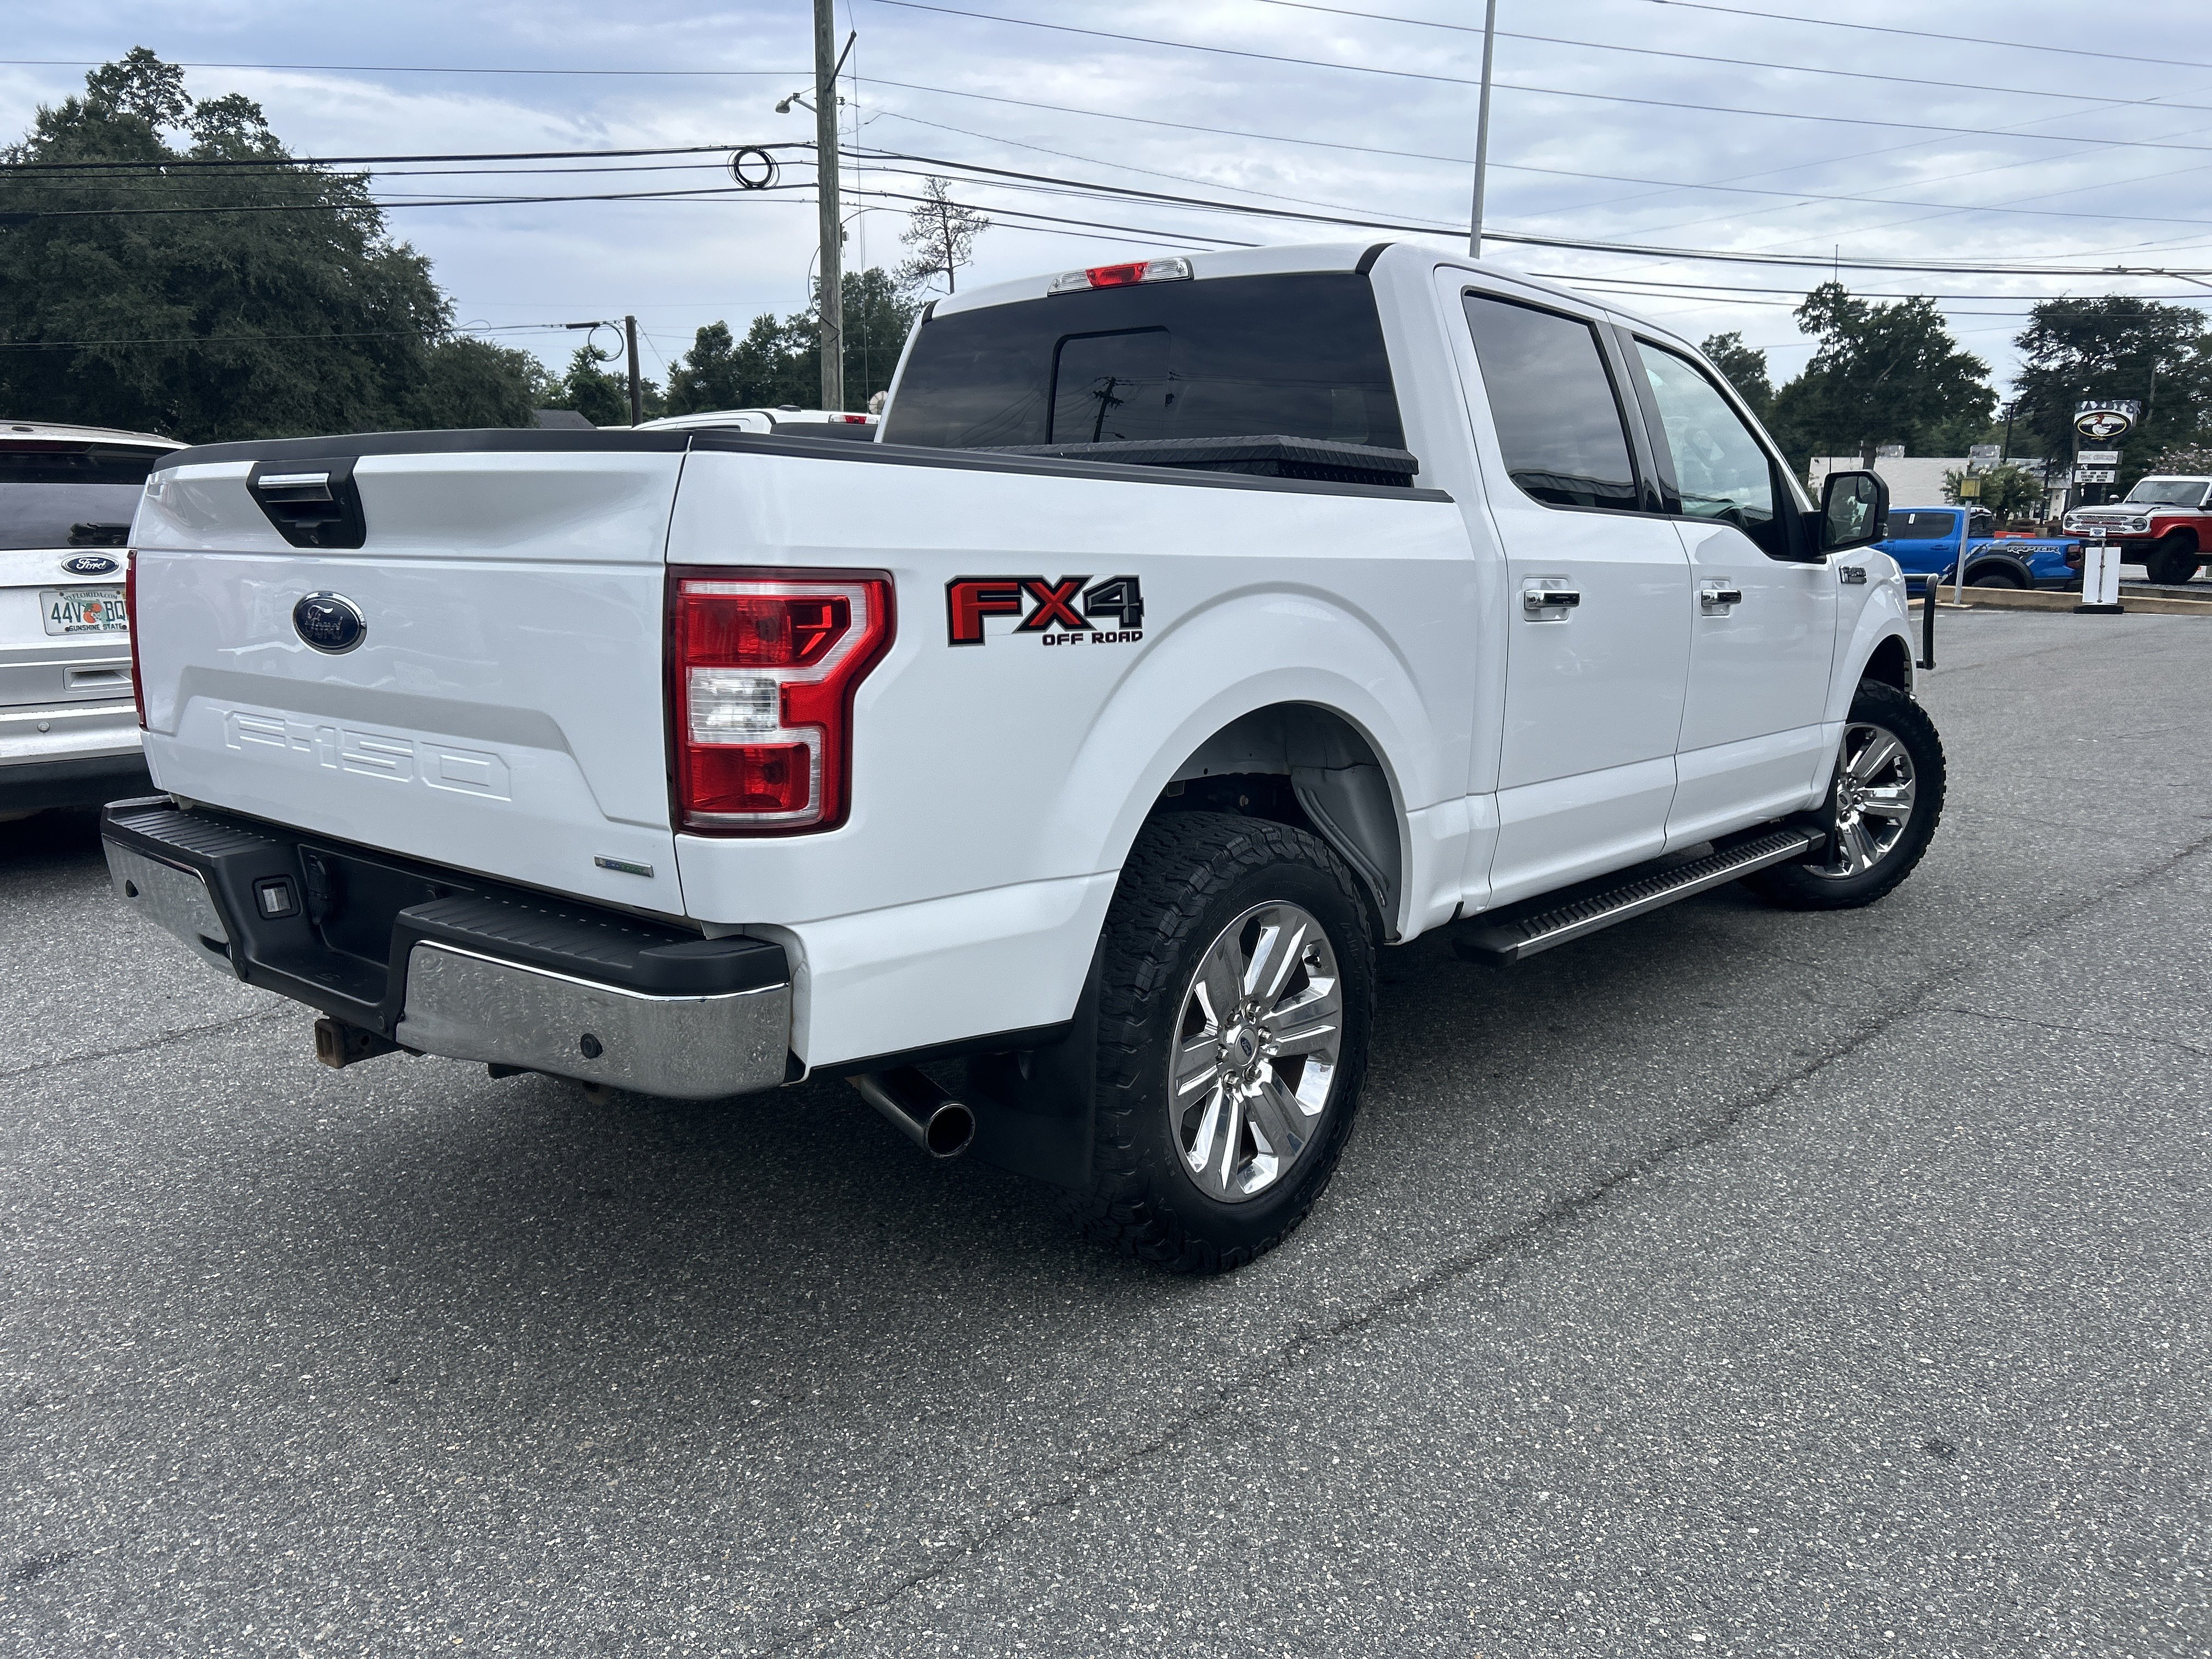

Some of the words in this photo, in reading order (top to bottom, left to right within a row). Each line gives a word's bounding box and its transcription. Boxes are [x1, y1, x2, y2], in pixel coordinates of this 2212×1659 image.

[76, 558, 107, 570] Ford
[51, 602, 81, 623] 44V
[103, 601, 128, 622] BQ
[944, 574, 1144, 647] FX4
[304, 605, 343, 641] Ford
[1042, 633, 1084, 646] OFF
[1091, 630, 1143, 644] ROAD
[224, 710, 512, 802] F-150
[1242, 1040, 1251, 1055] Ford
